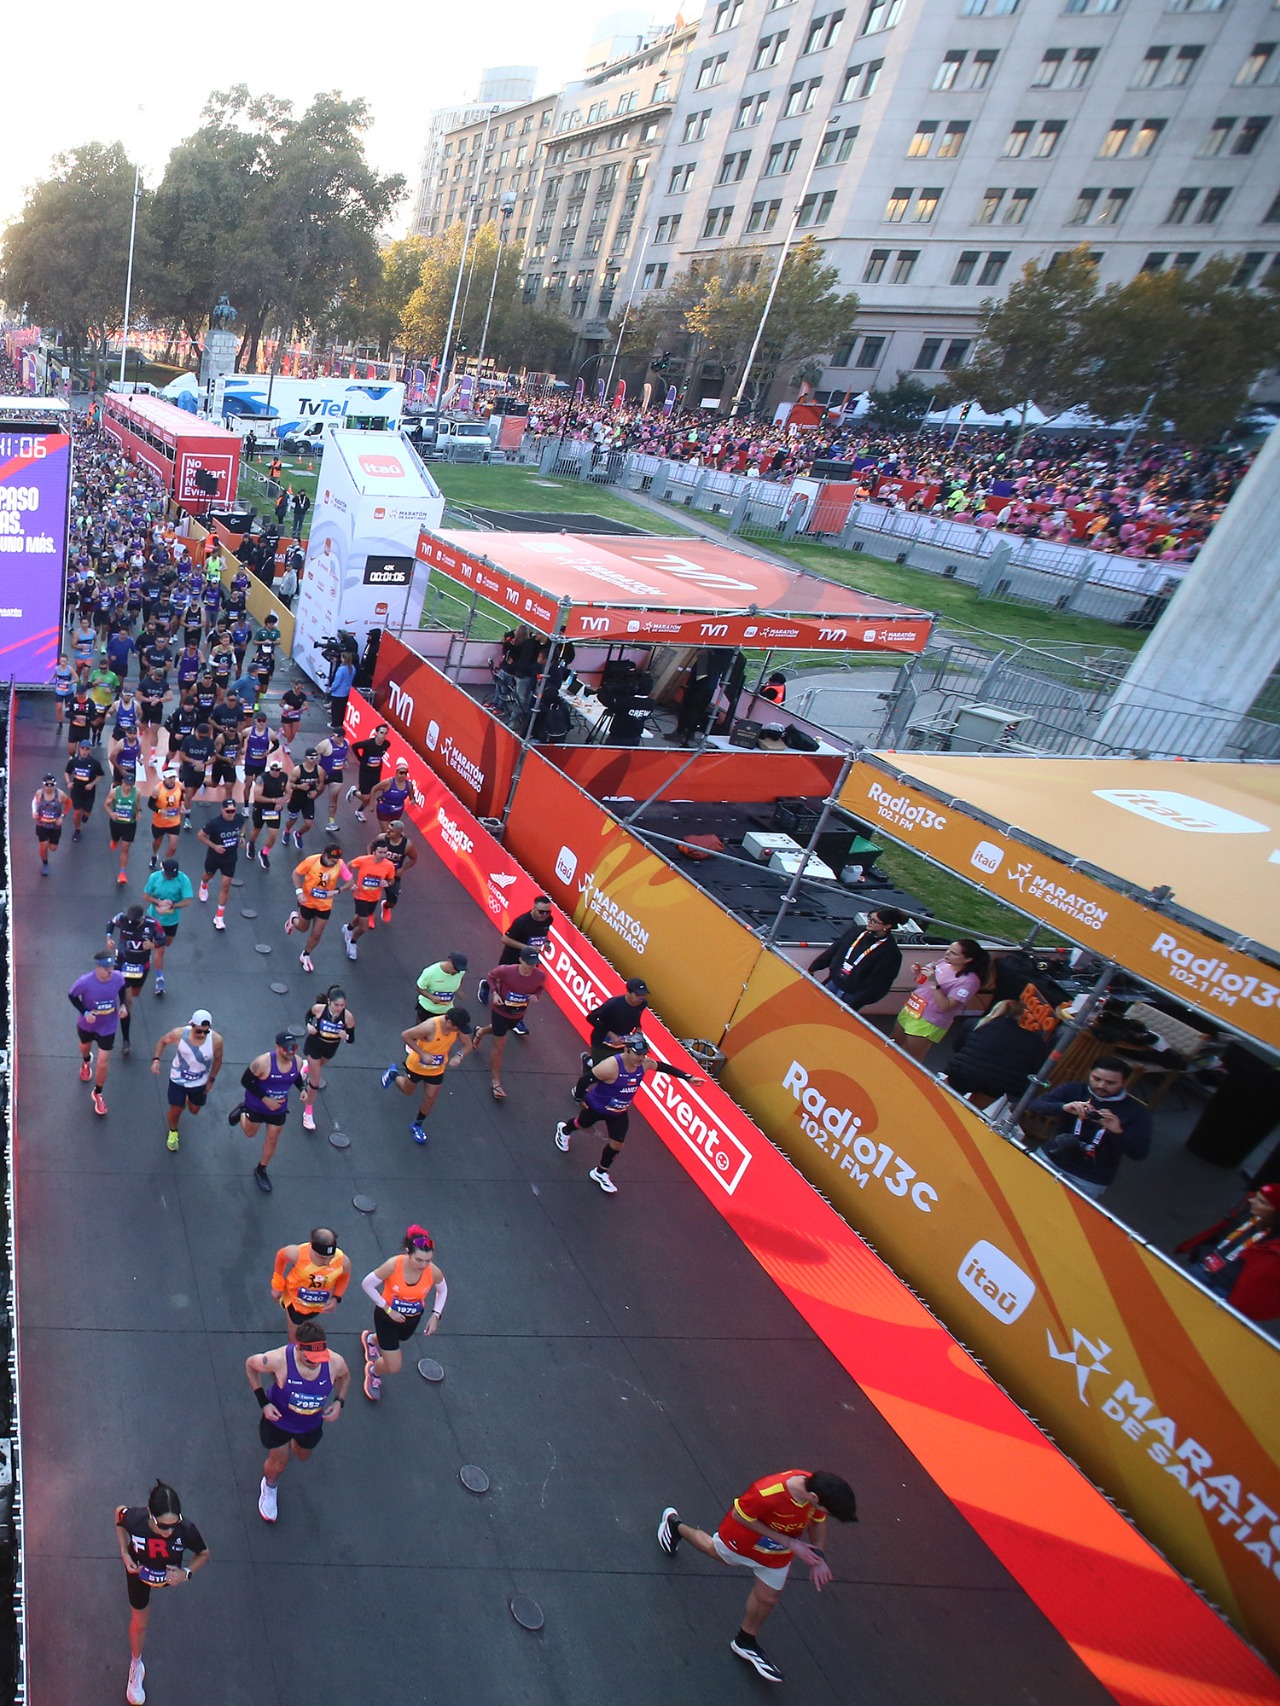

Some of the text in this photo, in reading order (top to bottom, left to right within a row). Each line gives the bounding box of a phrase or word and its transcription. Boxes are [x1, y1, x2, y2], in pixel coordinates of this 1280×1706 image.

[298, 397, 349, 417] TvTel
[186, 458, 202, 468] No
[363, 462, 402, 474] itaú
[0, 535, 25, 552] UNO
[369, 572, 406, 582] 00:01:06
[770, 628, 800, 636] MARATÓN
[888, 630, 917, 638] MARATÓN
[628, 709, 652, 718] CREW
[450, 757, 482, 793] DE SANTIAGO
[451, 747, 485, 785] MARATÓN
[867, 781, 948, 832] Radio13c
[876, 805, 915, 832] 102.1 FM
[437, 807, 474, 854] Radio13c
[557, 858, 572, 880] itaú
[974, 850, 998, 869] itaú
[592, 888, 650, 945] MARATÓN
[1027, 885, 1102, 930] DE SANTIAGO
[1032, 874, 1109, 922] MARATÓN
[590, 899, 645, 955] DE SANTIAGO
[1150, 931, 1280, 1009] Radio13
[1169, 965, 1239, 1007] 102.1 FM
[781, 1060, 939, 1213] Radio13c
[798, 1112, 871, 1190] 102.1 FM
[964, 1258, 1018, 1318] itaú
[397, 1305, 418, 1314] 1979
[1113, 1379, 1280, 1551] MARAT
[1101, 1397, 1280, 1582] DE SANTIA
